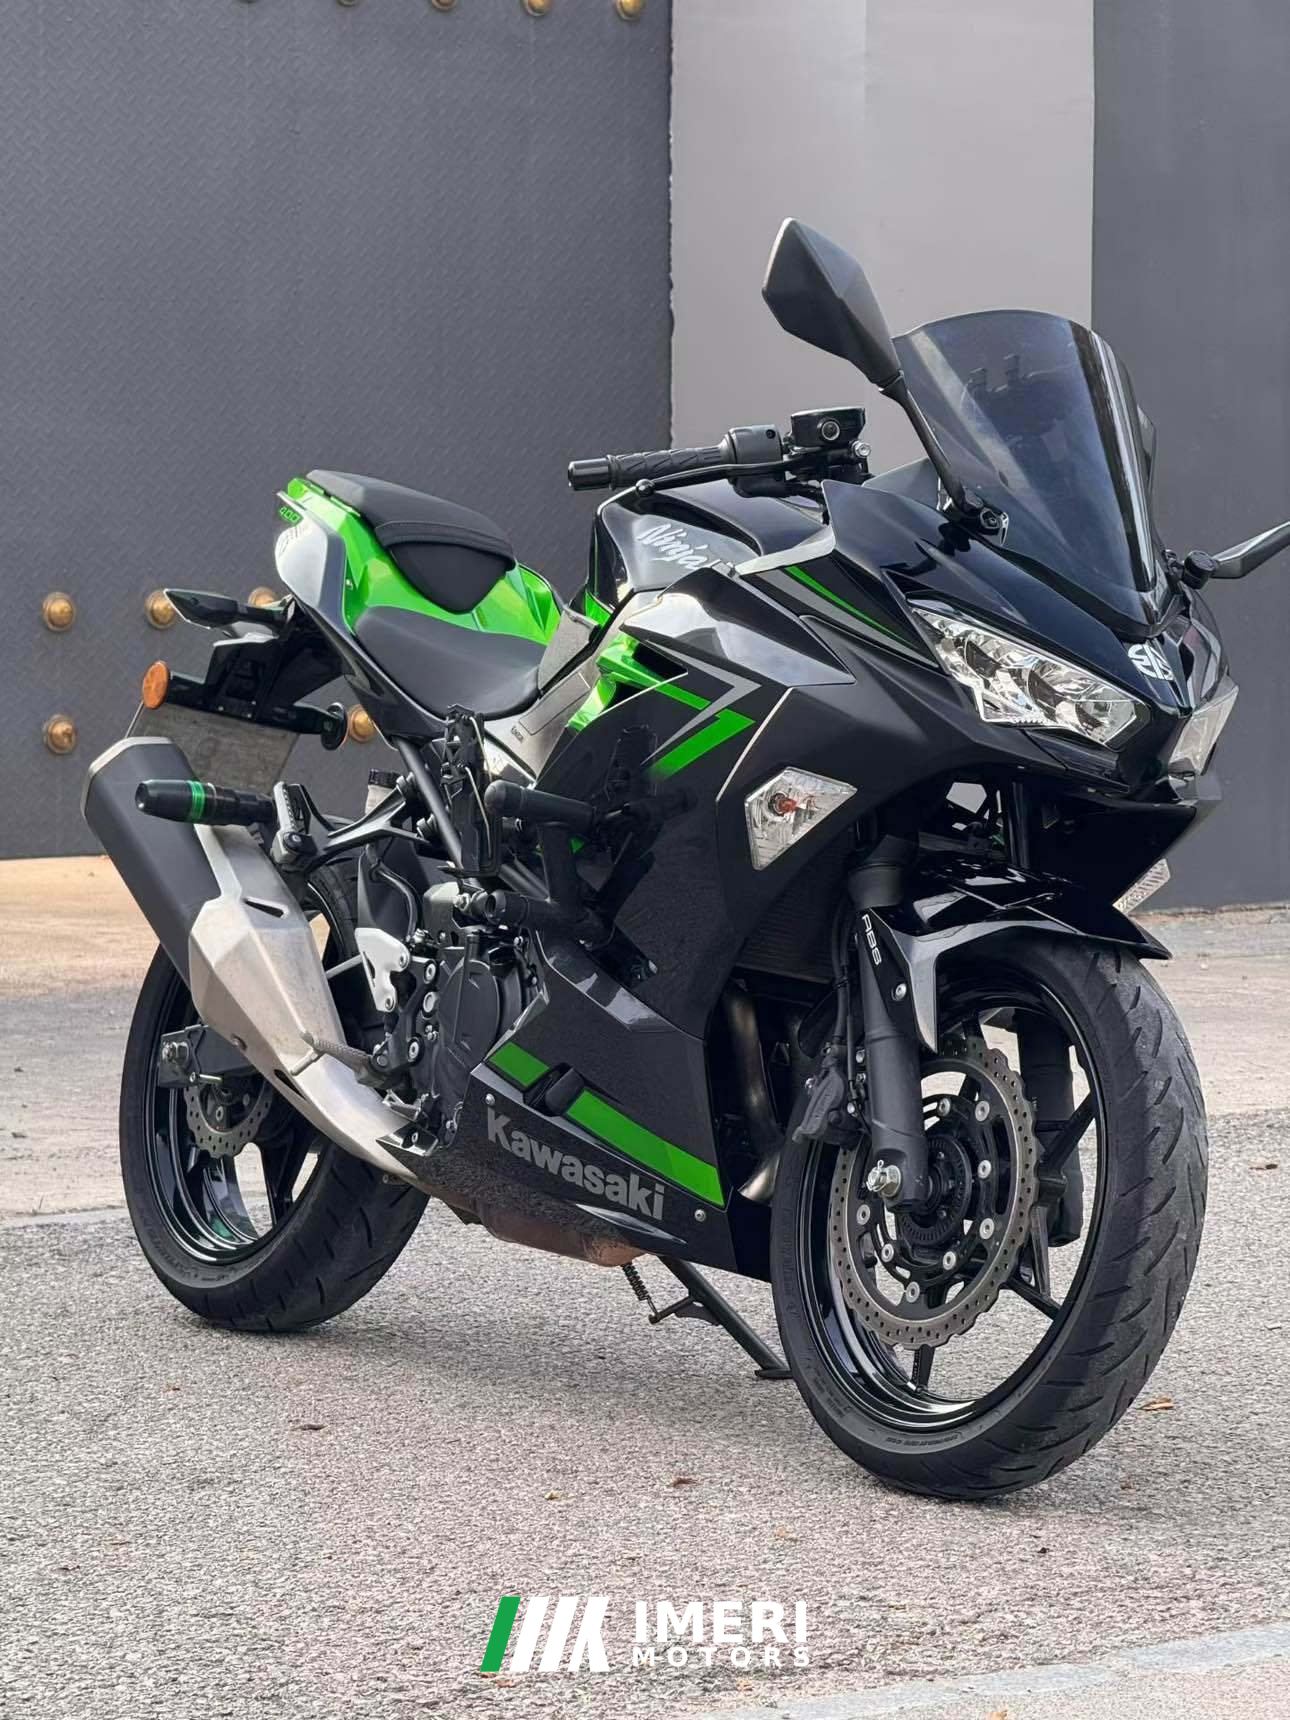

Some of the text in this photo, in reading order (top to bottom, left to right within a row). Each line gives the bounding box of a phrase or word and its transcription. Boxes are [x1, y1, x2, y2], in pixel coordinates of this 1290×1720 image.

[636, 523, 708, 570] Ninja
[861, 913, 882, 966] ABS
[486, 1106, 665, 1221] Kawasaki
